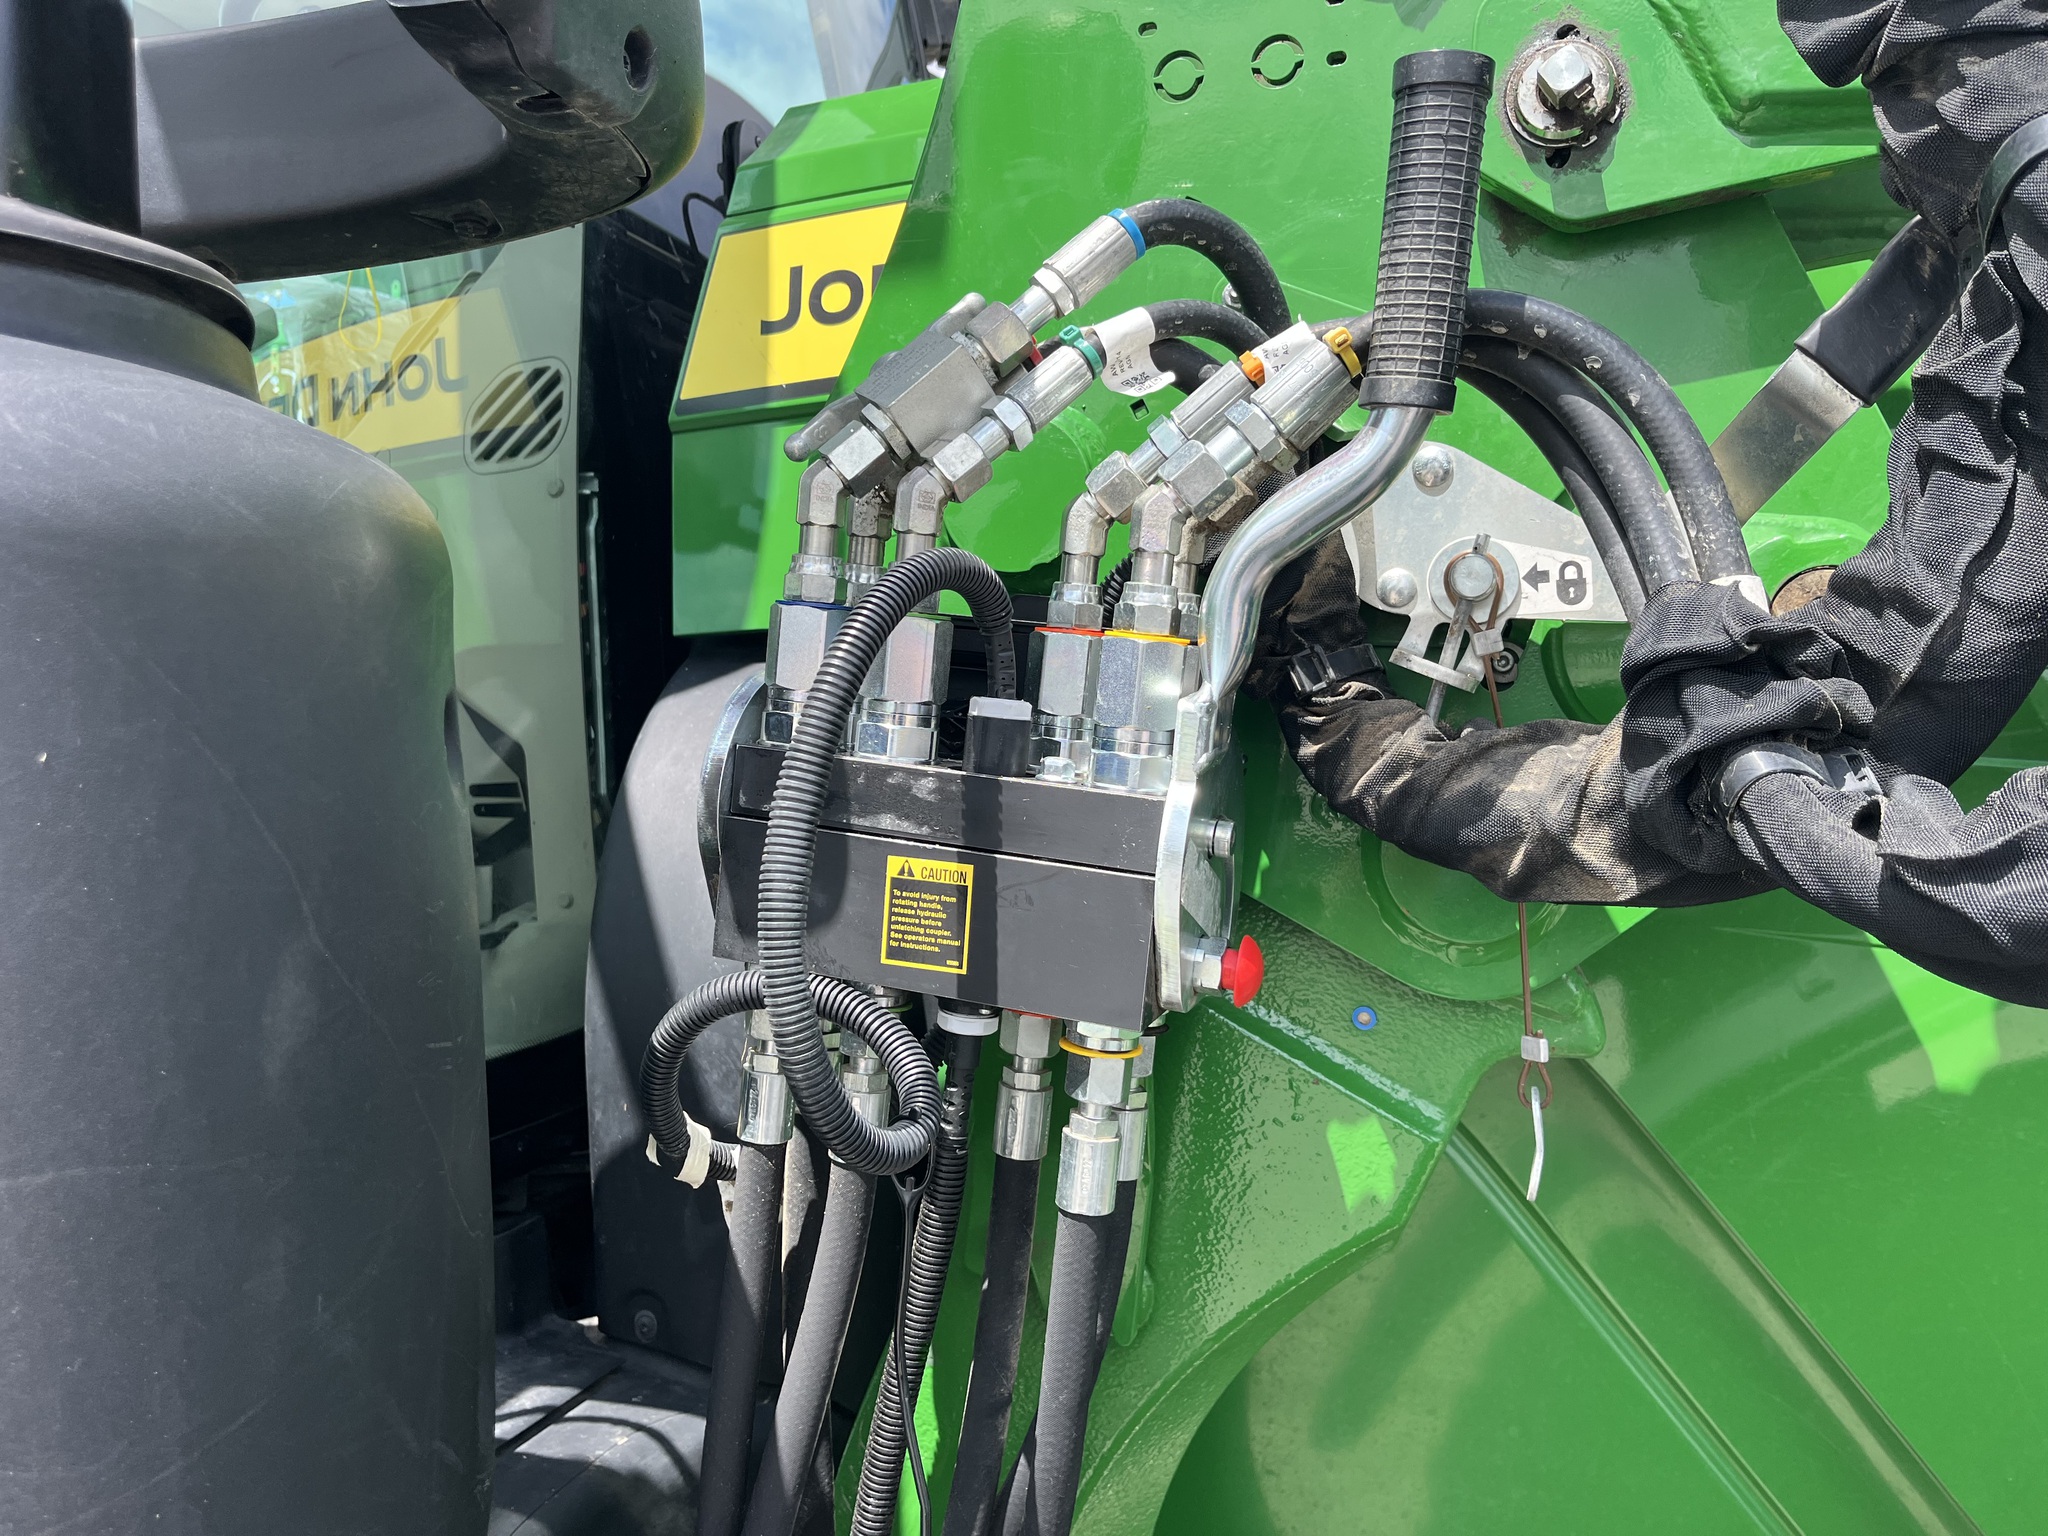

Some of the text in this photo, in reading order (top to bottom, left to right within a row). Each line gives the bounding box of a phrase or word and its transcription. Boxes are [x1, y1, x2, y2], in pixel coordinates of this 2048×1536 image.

[921, 867, 967, 884] CAUTION
[902, 891, 920, 899] avoid
[921, 893, 940, 902] injury
[941, 895, 957, 903] from
[892, 898, 943, 910] rotating handle,
[891, 907, 947, 919] release hydraulic
[891, 916, 942, 927] pressure before
[890, 924, 952, 937] unlatching coupler.
[890, 931, 961, 946] See operators manual
[900, 942, 941, 952] instructions.
